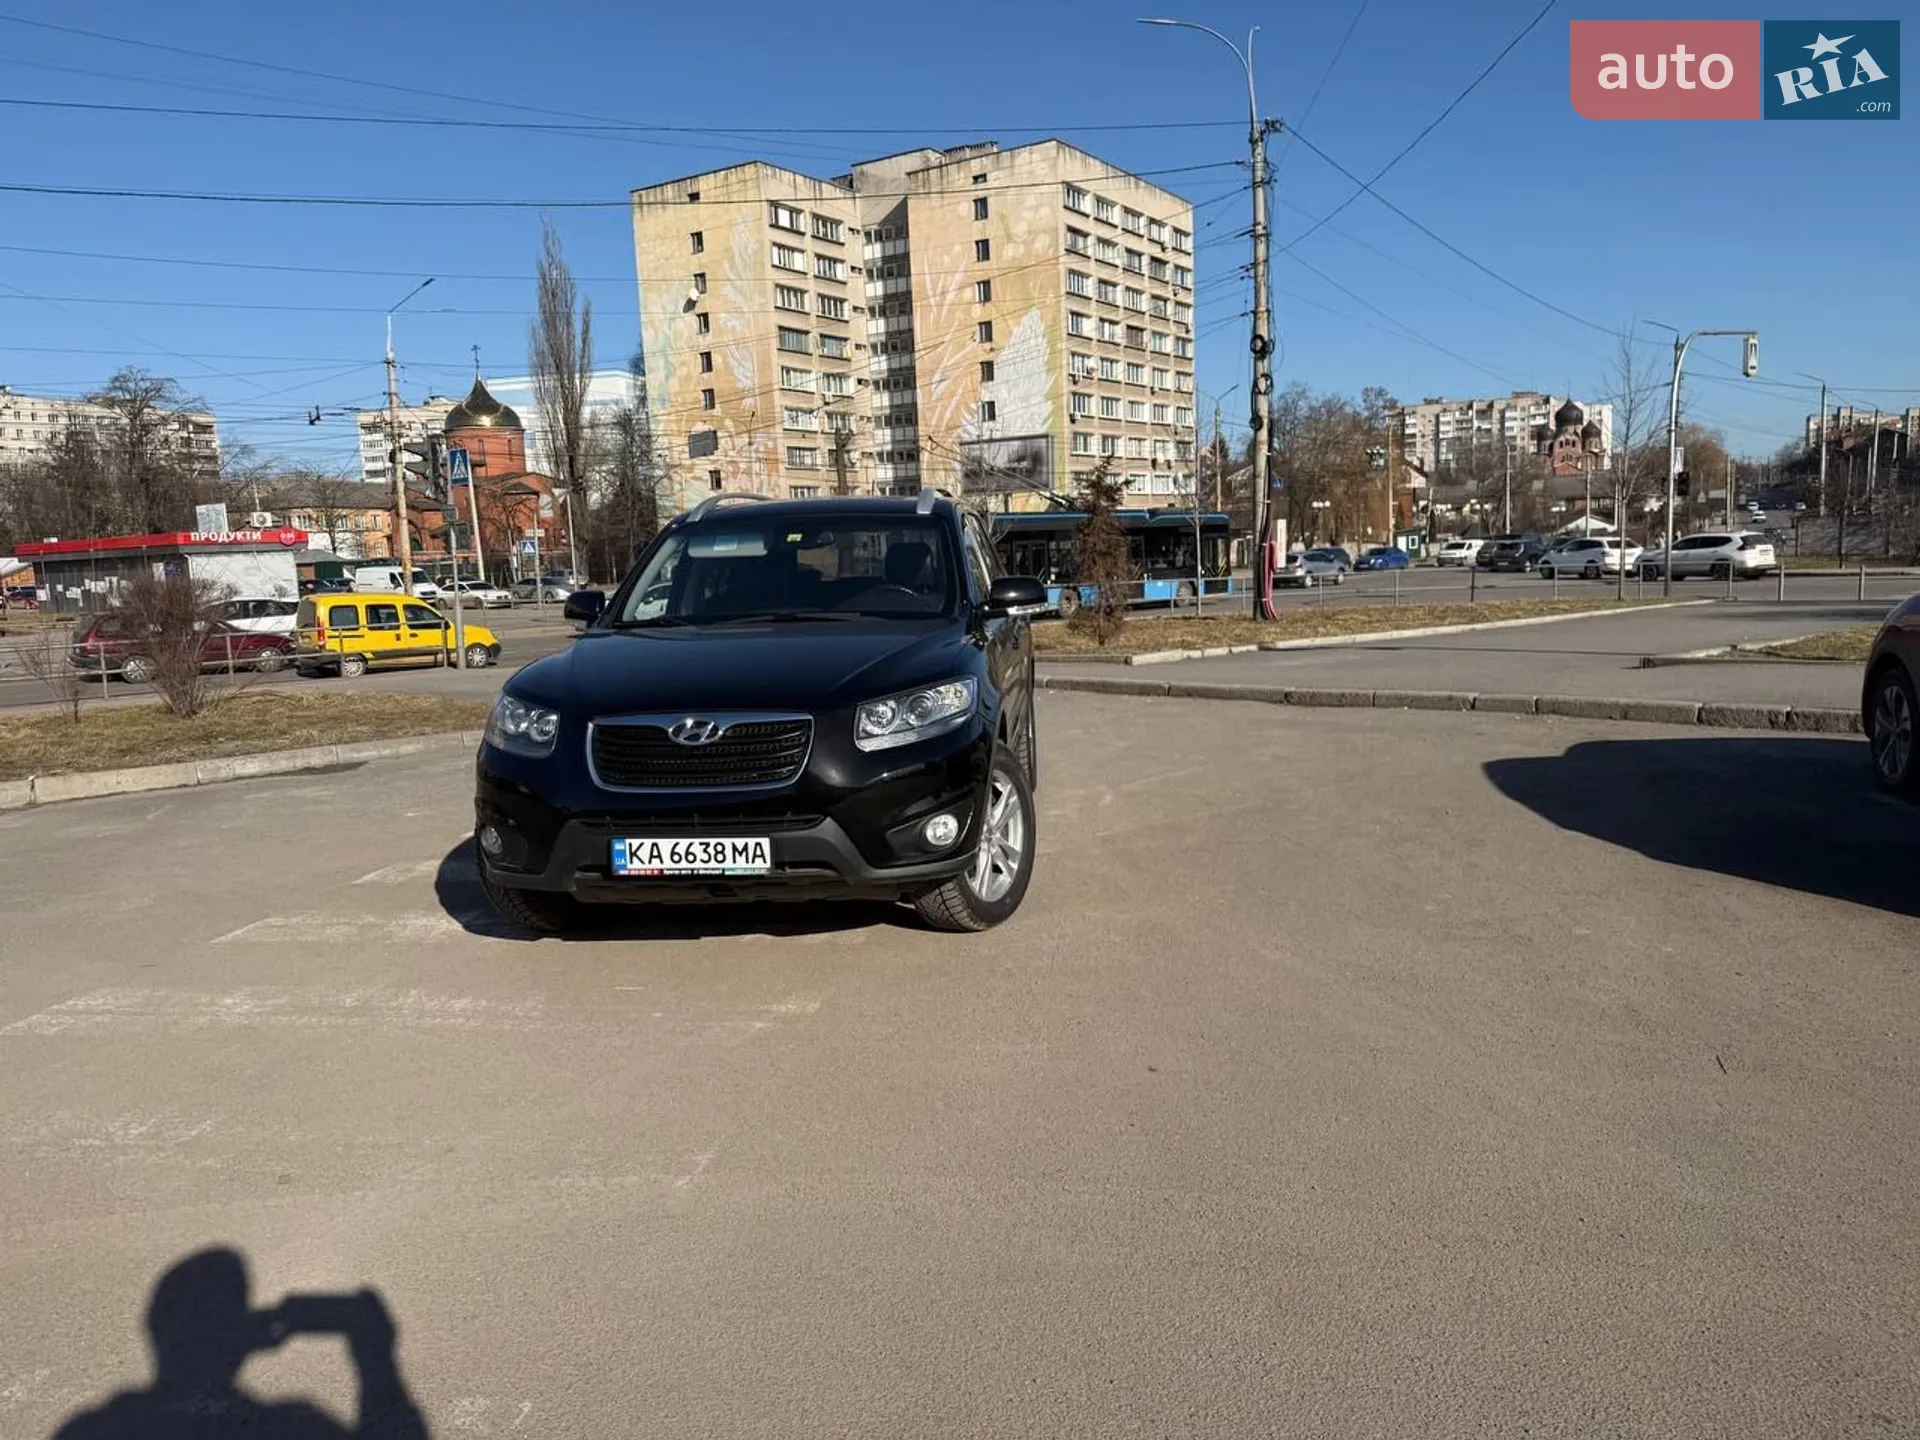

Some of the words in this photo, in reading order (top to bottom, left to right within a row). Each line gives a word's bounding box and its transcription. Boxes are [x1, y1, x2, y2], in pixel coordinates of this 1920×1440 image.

[190, 531, 262, 542] ПРОДУКТИ
[628, 842, 664, 865] KA
[670, 842, 727, 864] 6638
[731, 842, 768, 864] MA
